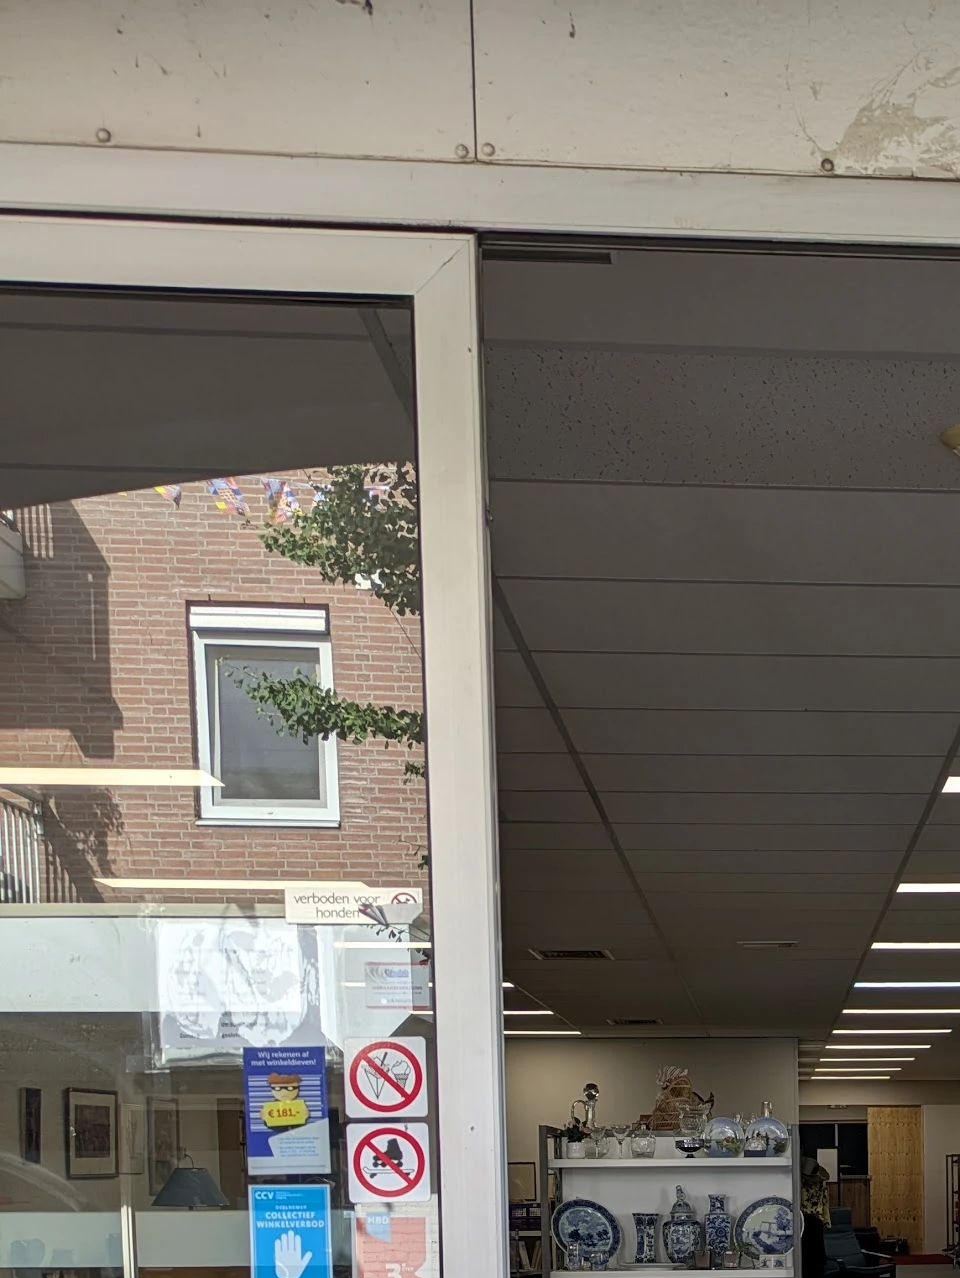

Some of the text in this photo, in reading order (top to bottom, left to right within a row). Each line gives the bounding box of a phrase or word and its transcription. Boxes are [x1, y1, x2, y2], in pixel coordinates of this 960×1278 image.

[294, 892, 381, 904] verboden voor
[316, 907, 359, 918] honden
[258, 1051, 270, 1059] Wij
[276, 1108, 300, 1118] 181,-
[255, 1191, 274, 1200] CCV
[265, 1211, 316, 1220] COLLECTIEF
[256, 1220, 325, 1228] WINKELVERBOD
